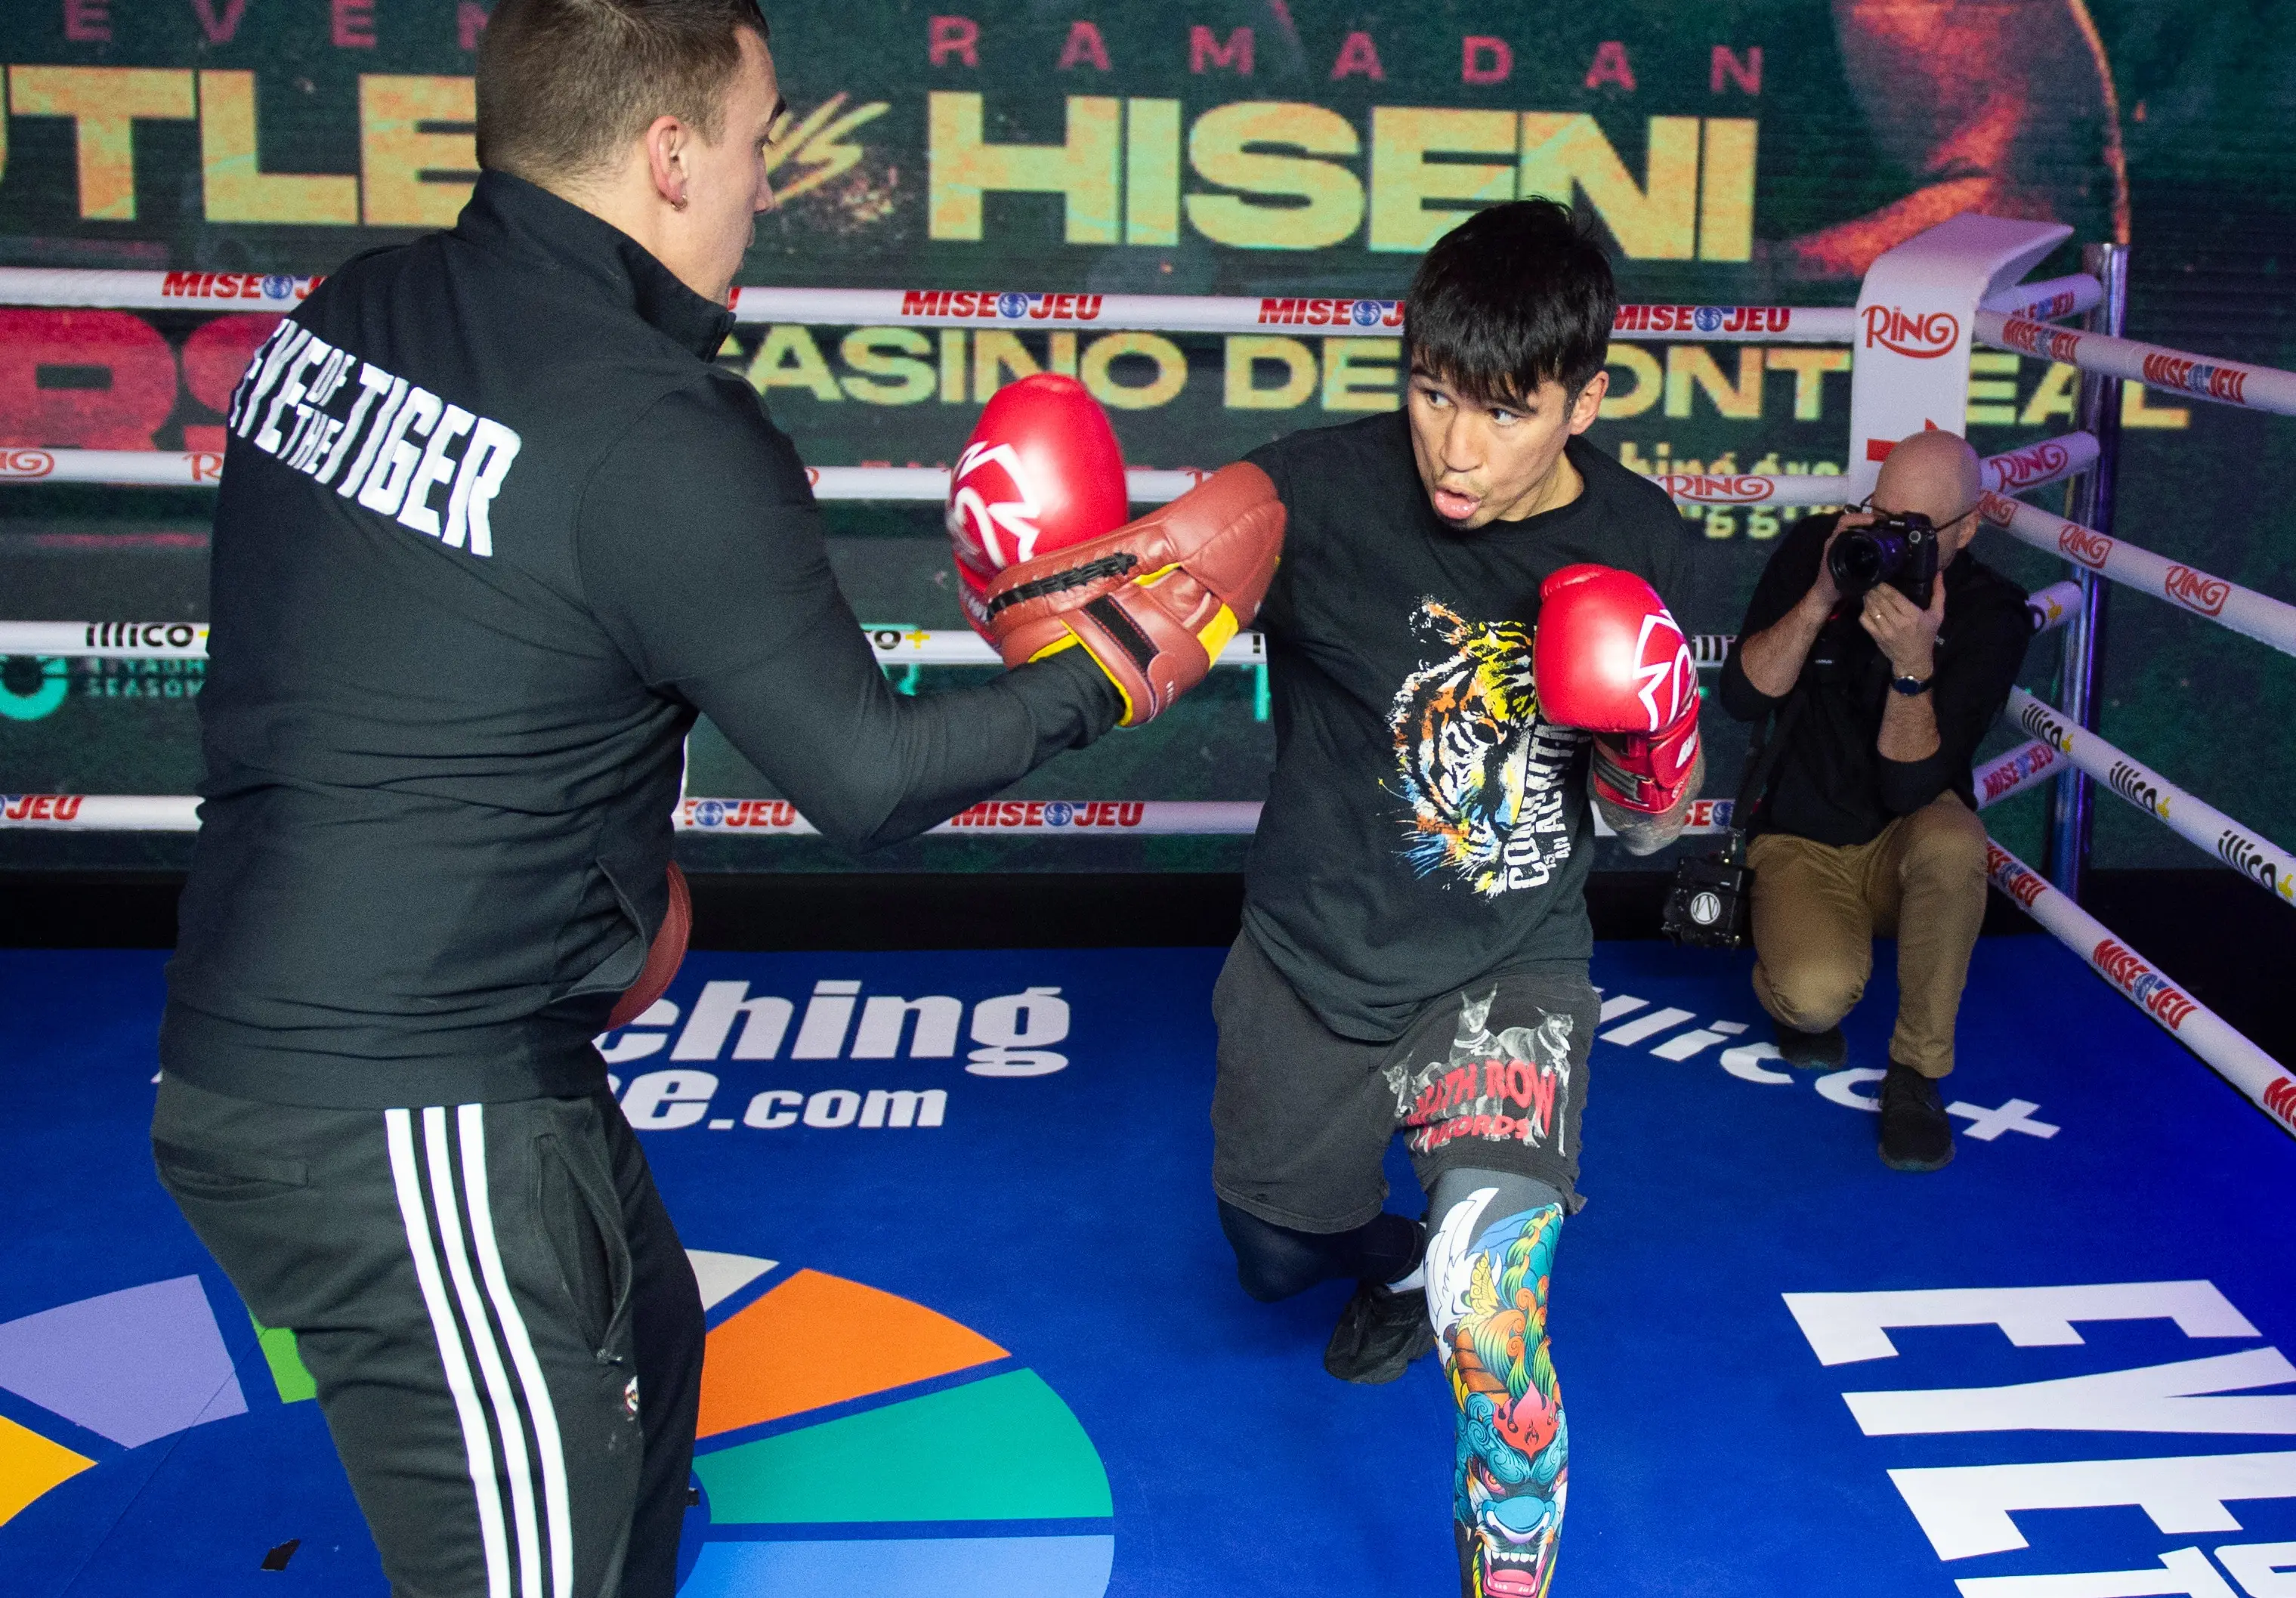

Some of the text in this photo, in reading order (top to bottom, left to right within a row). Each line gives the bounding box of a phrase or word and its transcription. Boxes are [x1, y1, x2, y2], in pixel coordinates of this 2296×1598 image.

[929, 15, 1763, 95] RAMADAN
[0, 64, 477, 227] TLE
[928, 91, 1759, 261] HISENI
[1862, 304, 1959, 358] RING
[306, 348, 356, 406] OF
[716, 325, 1188, 410] ASINO
[1224, 335, 1402, 410] DE
[277, 403, 345, 475] THE
[314, 363, 522, 557] TIGER
[1990, 444, 2069, 492] RING
[1658, 475, 1775, 503] RING
[1977, 490, 2019, 527] ING
[2058, 524, 2113, 569] RING
[2164, 564, 2231, 617] RING
[607, 1068, 947, 1130] e.com
[1484, 1058, 1556, 1136] ROW
[1781, 1279, 2296, 1562] EYE
